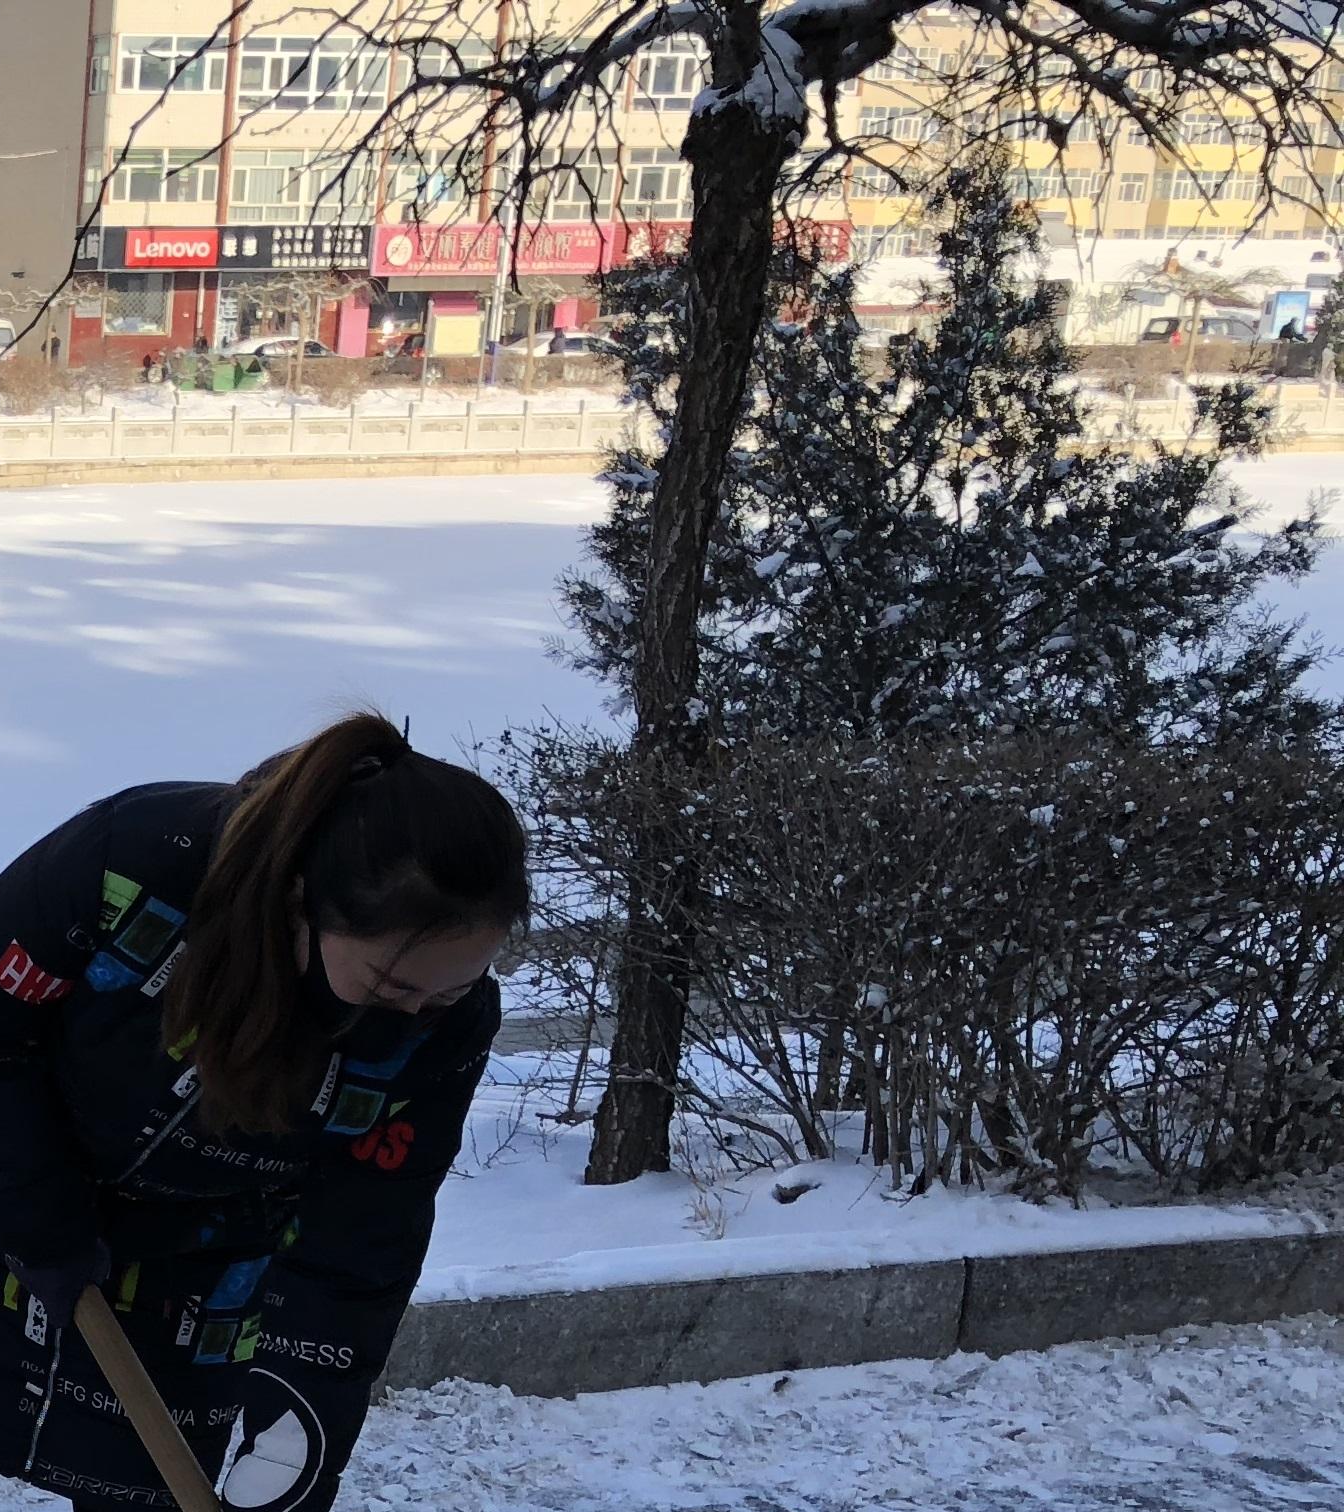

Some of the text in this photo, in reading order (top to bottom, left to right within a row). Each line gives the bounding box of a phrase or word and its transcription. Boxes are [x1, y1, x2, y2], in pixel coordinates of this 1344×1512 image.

[133, 238, 211, 258] Lenovo
[200, 1144, 251, 1167] SHIE
[91, 1393, 128, 1418] SHI
